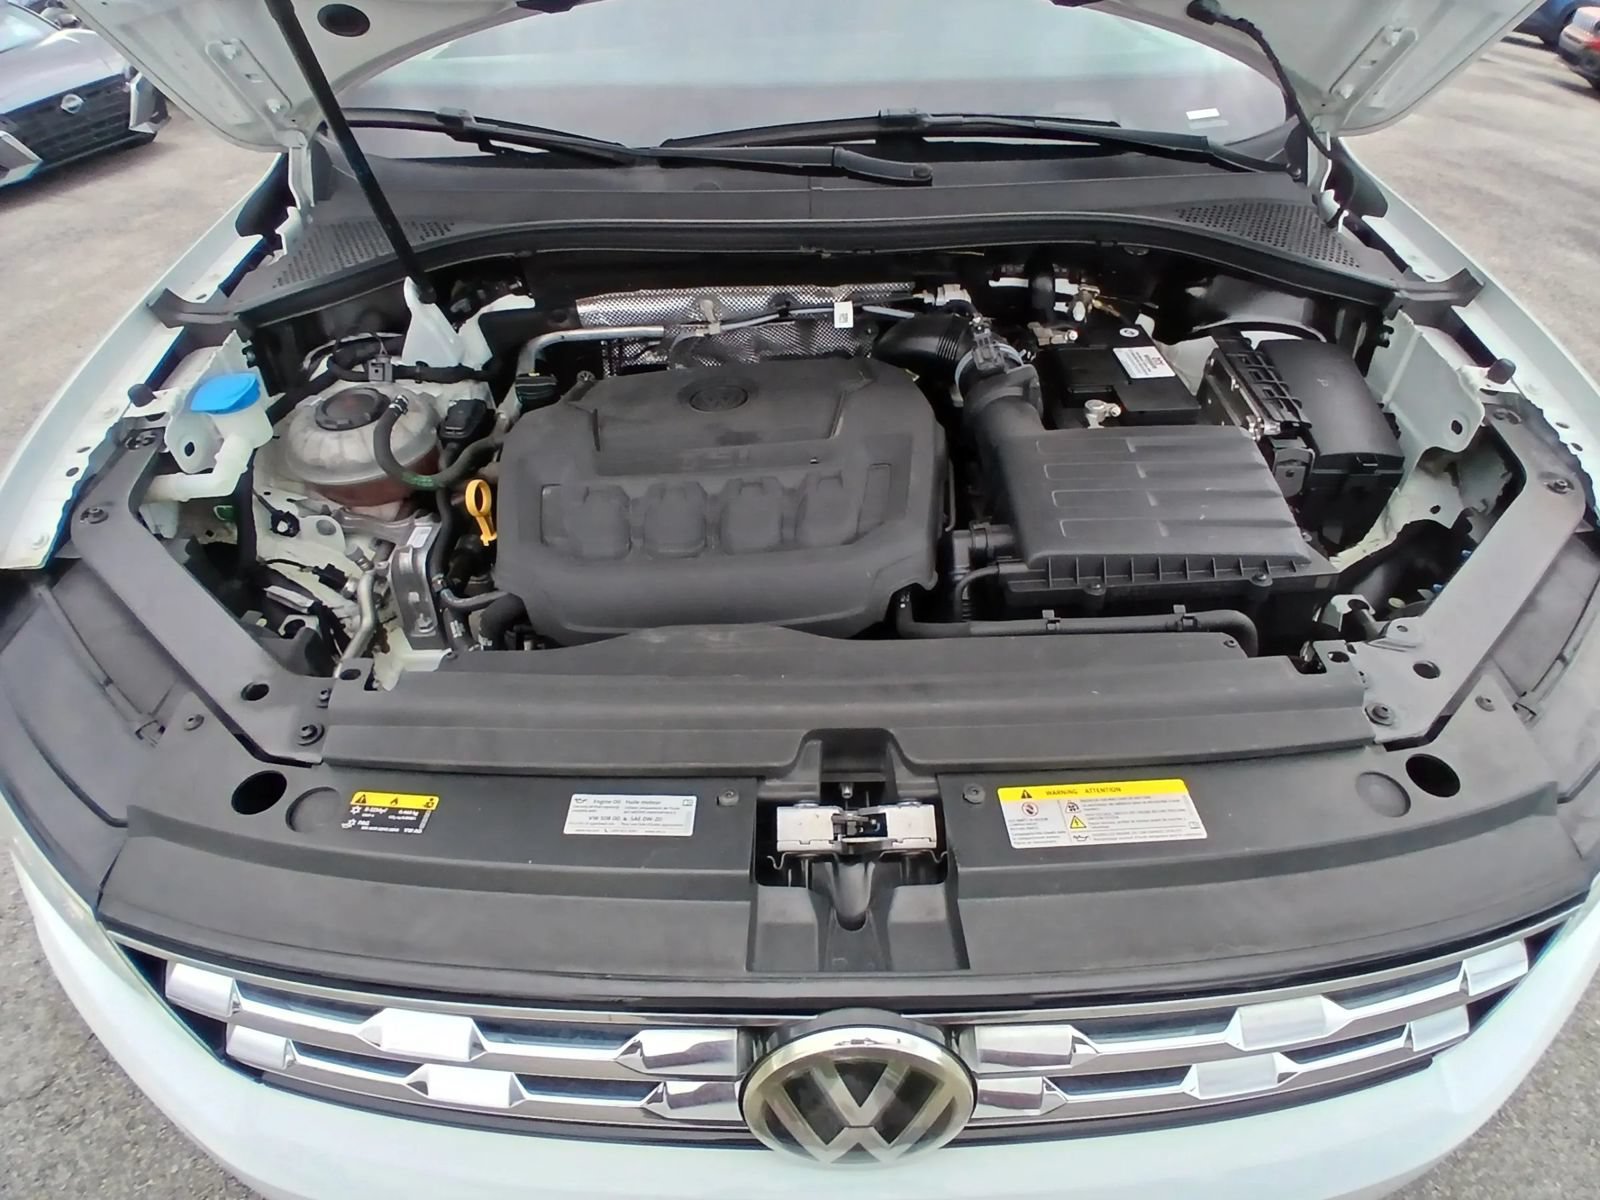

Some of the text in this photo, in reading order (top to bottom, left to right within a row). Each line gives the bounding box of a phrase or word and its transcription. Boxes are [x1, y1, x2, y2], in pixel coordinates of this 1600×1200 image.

[1045, 786, 1122, 796] WARNING ATTENTION
[754, 1050, 963, 1166] VW
